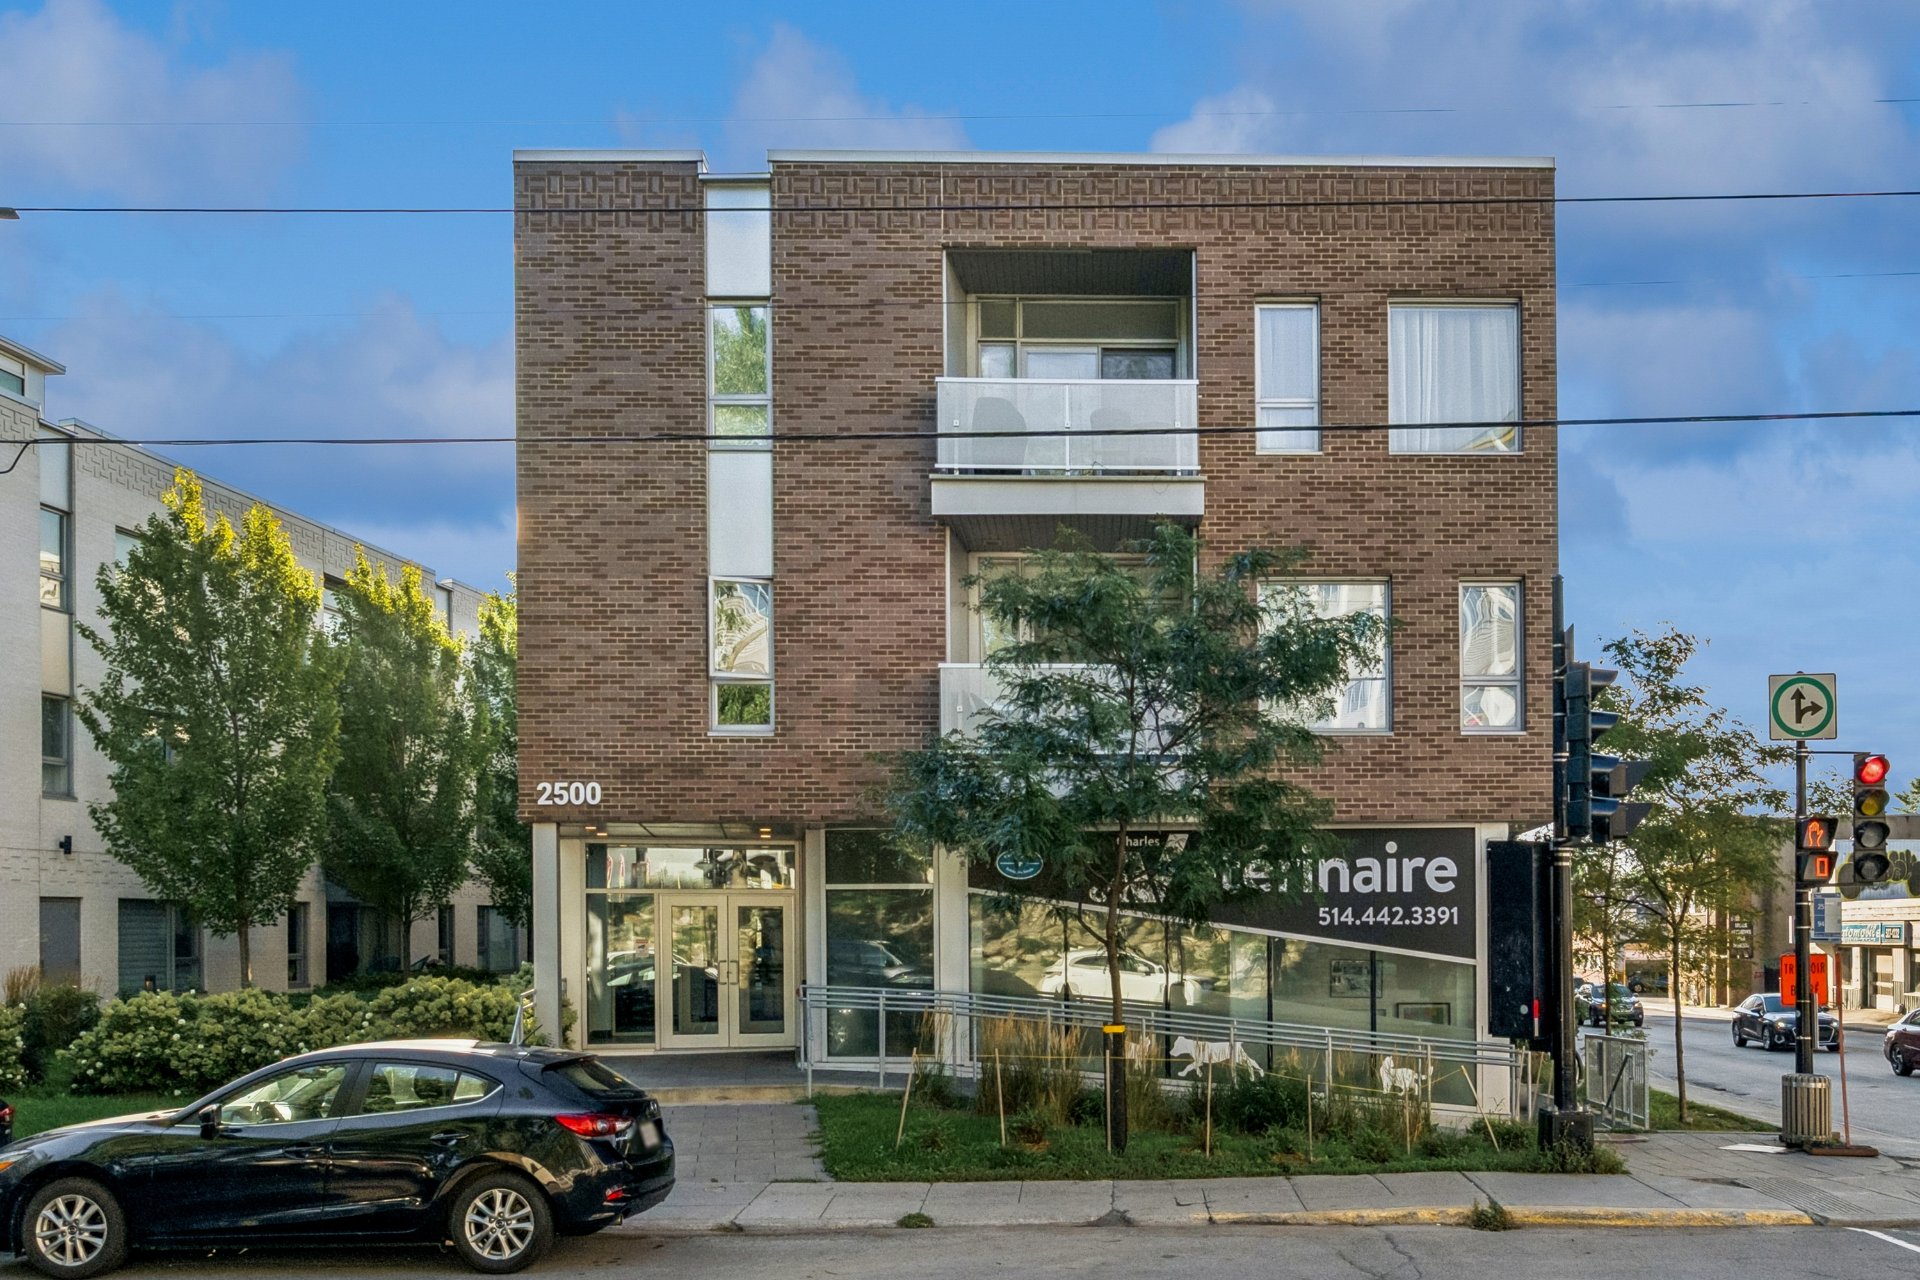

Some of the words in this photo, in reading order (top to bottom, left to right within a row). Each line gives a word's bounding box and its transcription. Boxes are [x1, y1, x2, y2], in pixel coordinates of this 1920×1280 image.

[537, 782, 601, 805] 2500
[1318, 906, 1459, 926] 514.442.3391
[1783, 962, 1825, 975] TROIR
